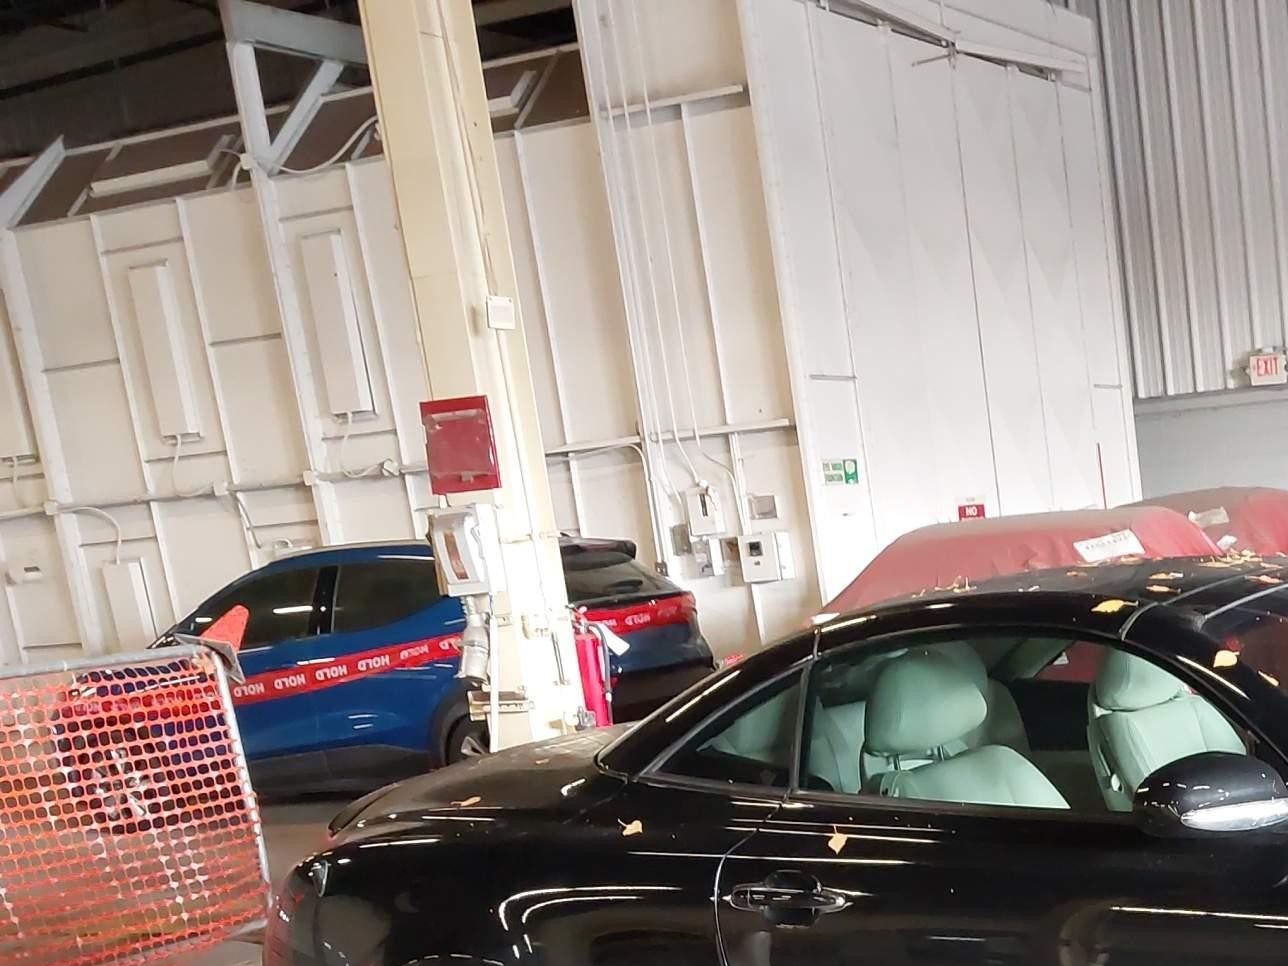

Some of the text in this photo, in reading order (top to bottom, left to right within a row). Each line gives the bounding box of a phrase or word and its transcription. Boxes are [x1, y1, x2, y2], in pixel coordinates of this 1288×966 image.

[1256, 356, 1279, 377] EXIT
[965, 505, 978, 516] NO
[357, 654, 390, 672] HOLD
[315, 664, 348, 681] HOLD
[233, 682, 265, 698] HOLD
[273, 673, 306, 690] HOLD
